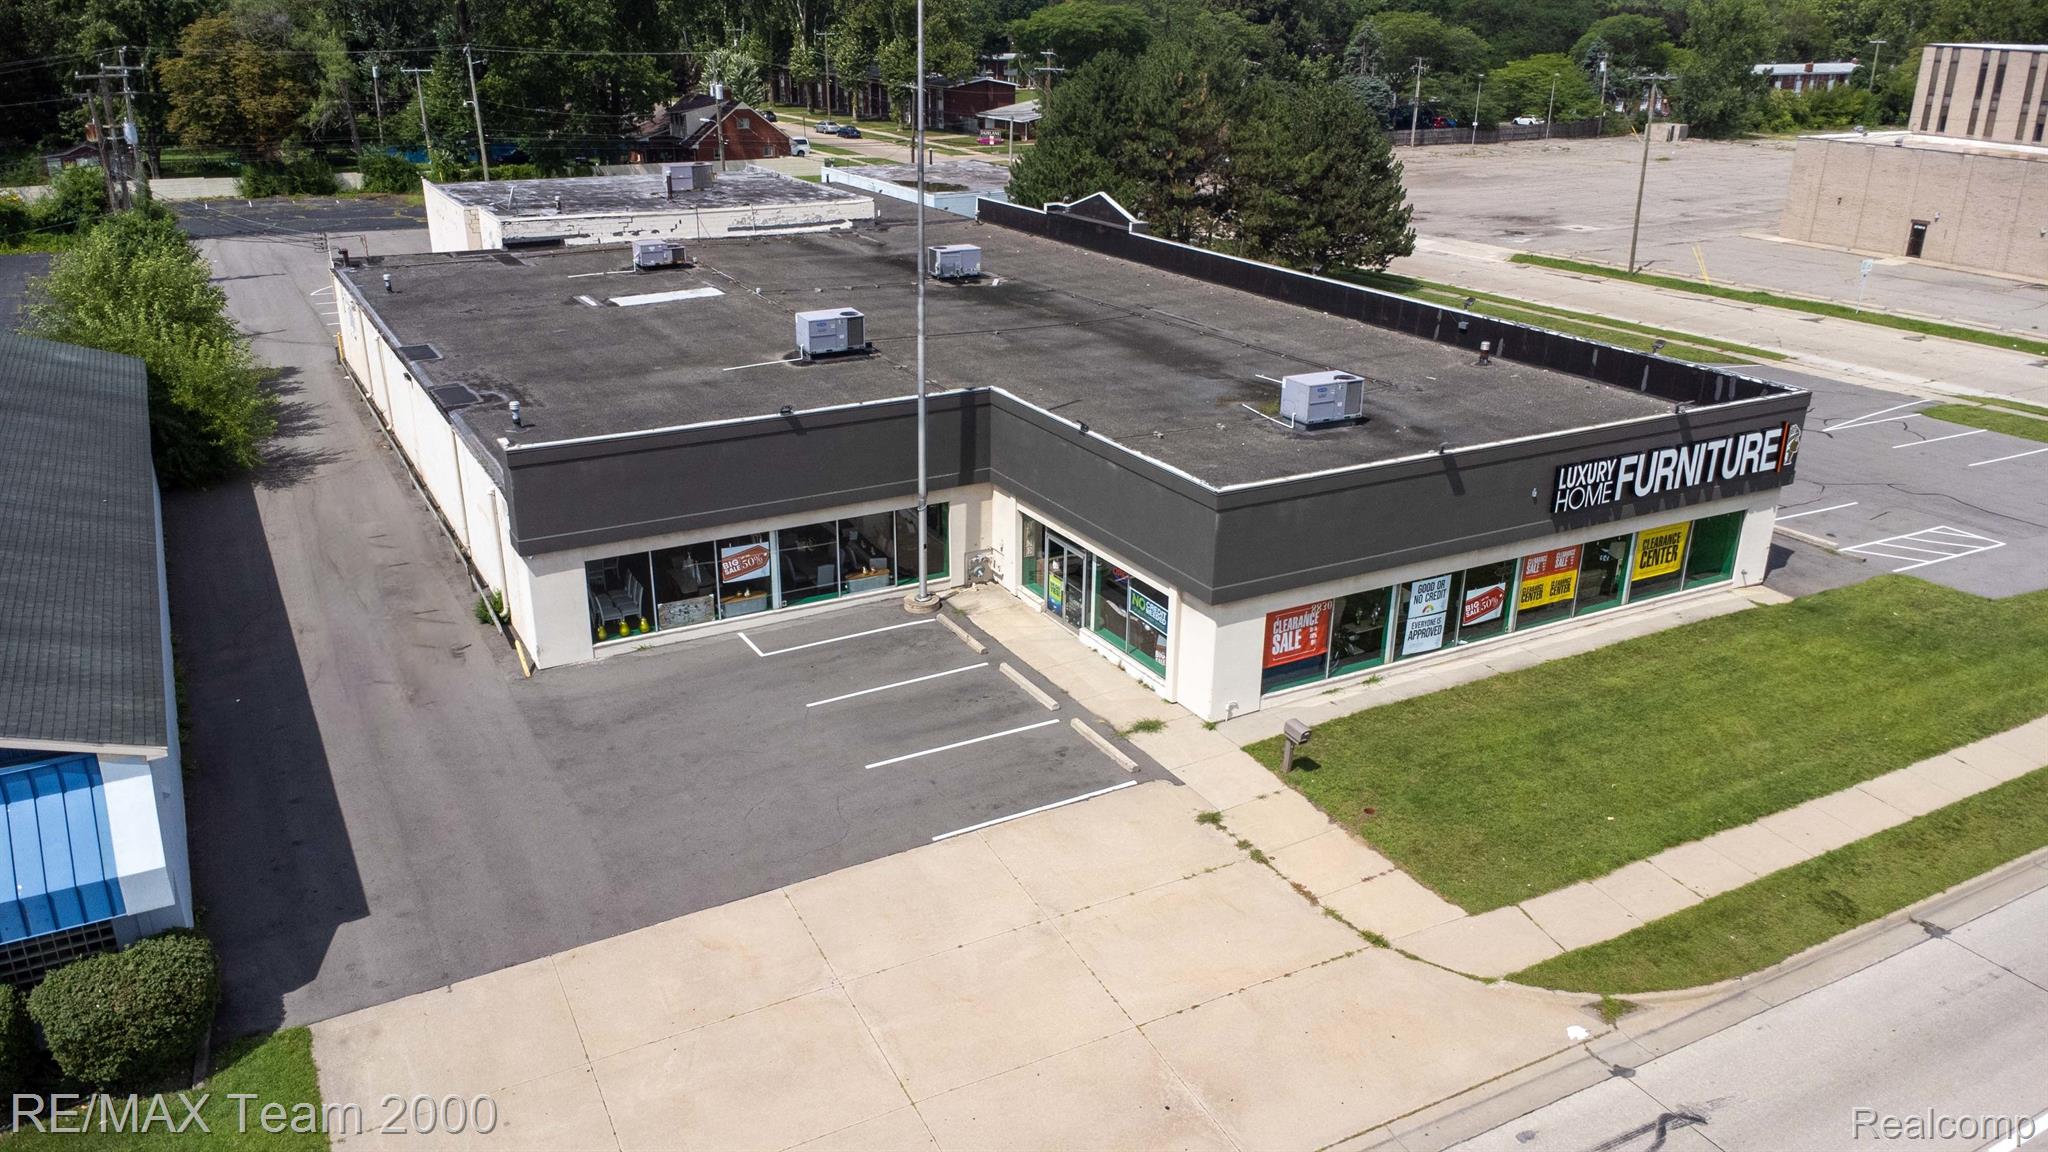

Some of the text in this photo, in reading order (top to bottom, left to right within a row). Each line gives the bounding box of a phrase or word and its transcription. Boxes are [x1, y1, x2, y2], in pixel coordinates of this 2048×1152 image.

[1558, 428, 1783, 501] LUXURY FURNITURE
[1554, 481, 1613, 513] HOME
[1642, 532, 1682, 550] CLEARANCE
[722, 559, 739, 570] BIG
[742, 554, 763, 569] 50%
[1639, 545, 1679, 569] CENTER
[724, 565, 741, 575] SALE
[1417, 580, 1446, 594] GOOD OR
[1549, 583, 1571, 597] CENTER
[1132, 592, 1146, 610] NO
[1413, 589, 1448, 605] NO CREDIT
[1520, 590, 1543, 603] CENTER
[1465, 601, 1480, 612] BIG
[1465, 608, 1480, 618] SALE
[1273, 611, 1319, 635] CLEARANCE
[1411, 619, 1436, 630] EVERYONE
[1407, 625, 1442, 641] APPROVED
[1272, 629, 1302, 655] SALE
